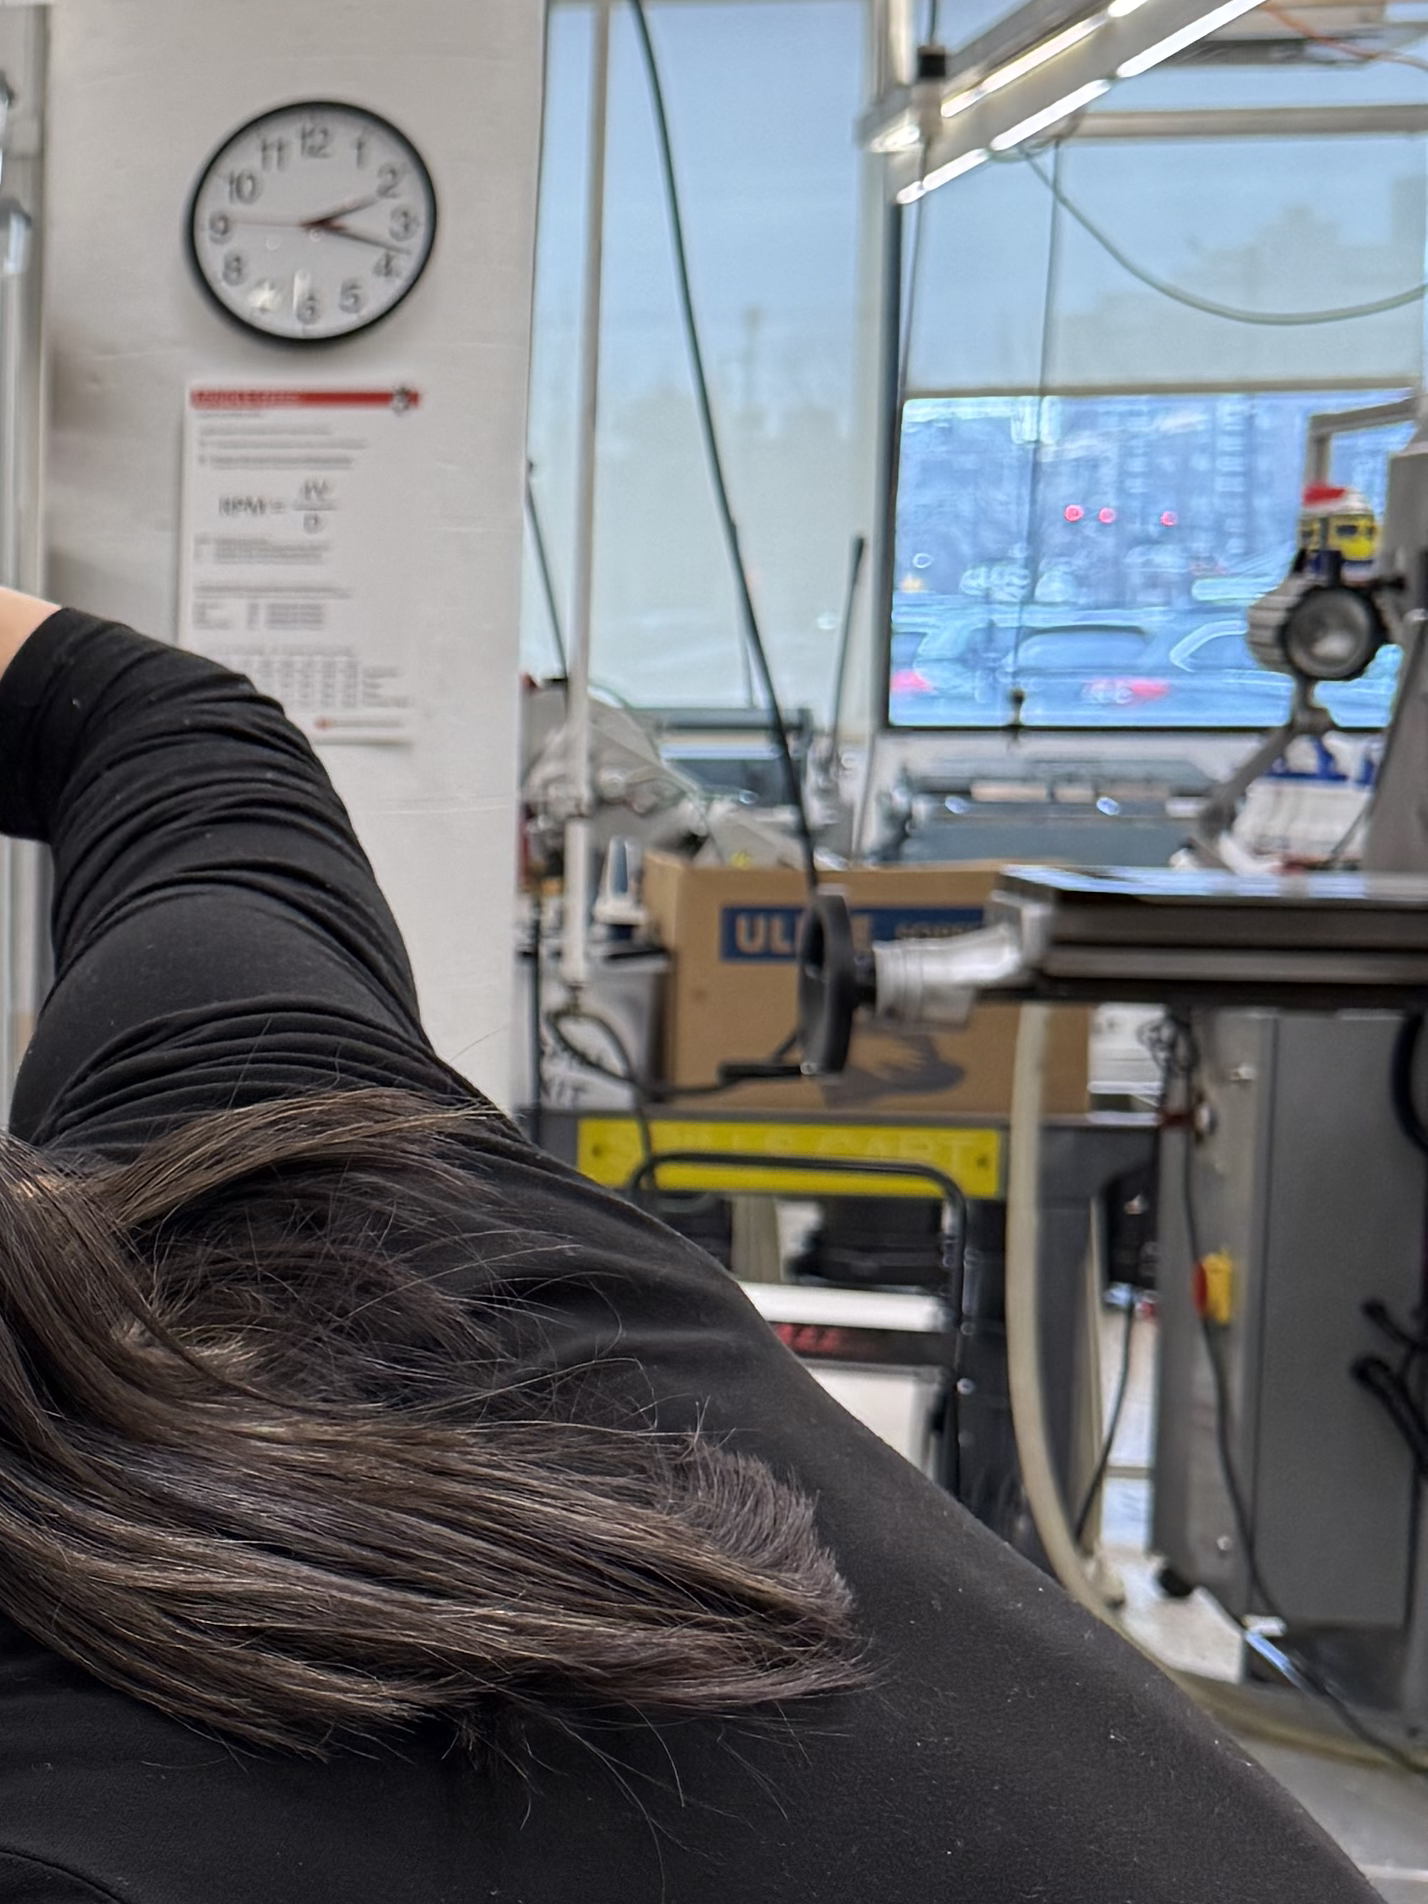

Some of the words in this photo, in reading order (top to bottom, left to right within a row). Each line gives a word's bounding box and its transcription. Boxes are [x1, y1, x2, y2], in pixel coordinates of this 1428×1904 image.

[261, 137, 286, 172] 11
[301, 124, 334, 159] 12
[355, 135, 369, 170] 1
[228, 169, 259, 205] 10
[376, 162, 401, 199] 2
[389, 206, 417, 243] 3
[222, 251, 245, 287] 8
[296, 287, 321, 325] 6
[338, 277, 365, 315] 5
